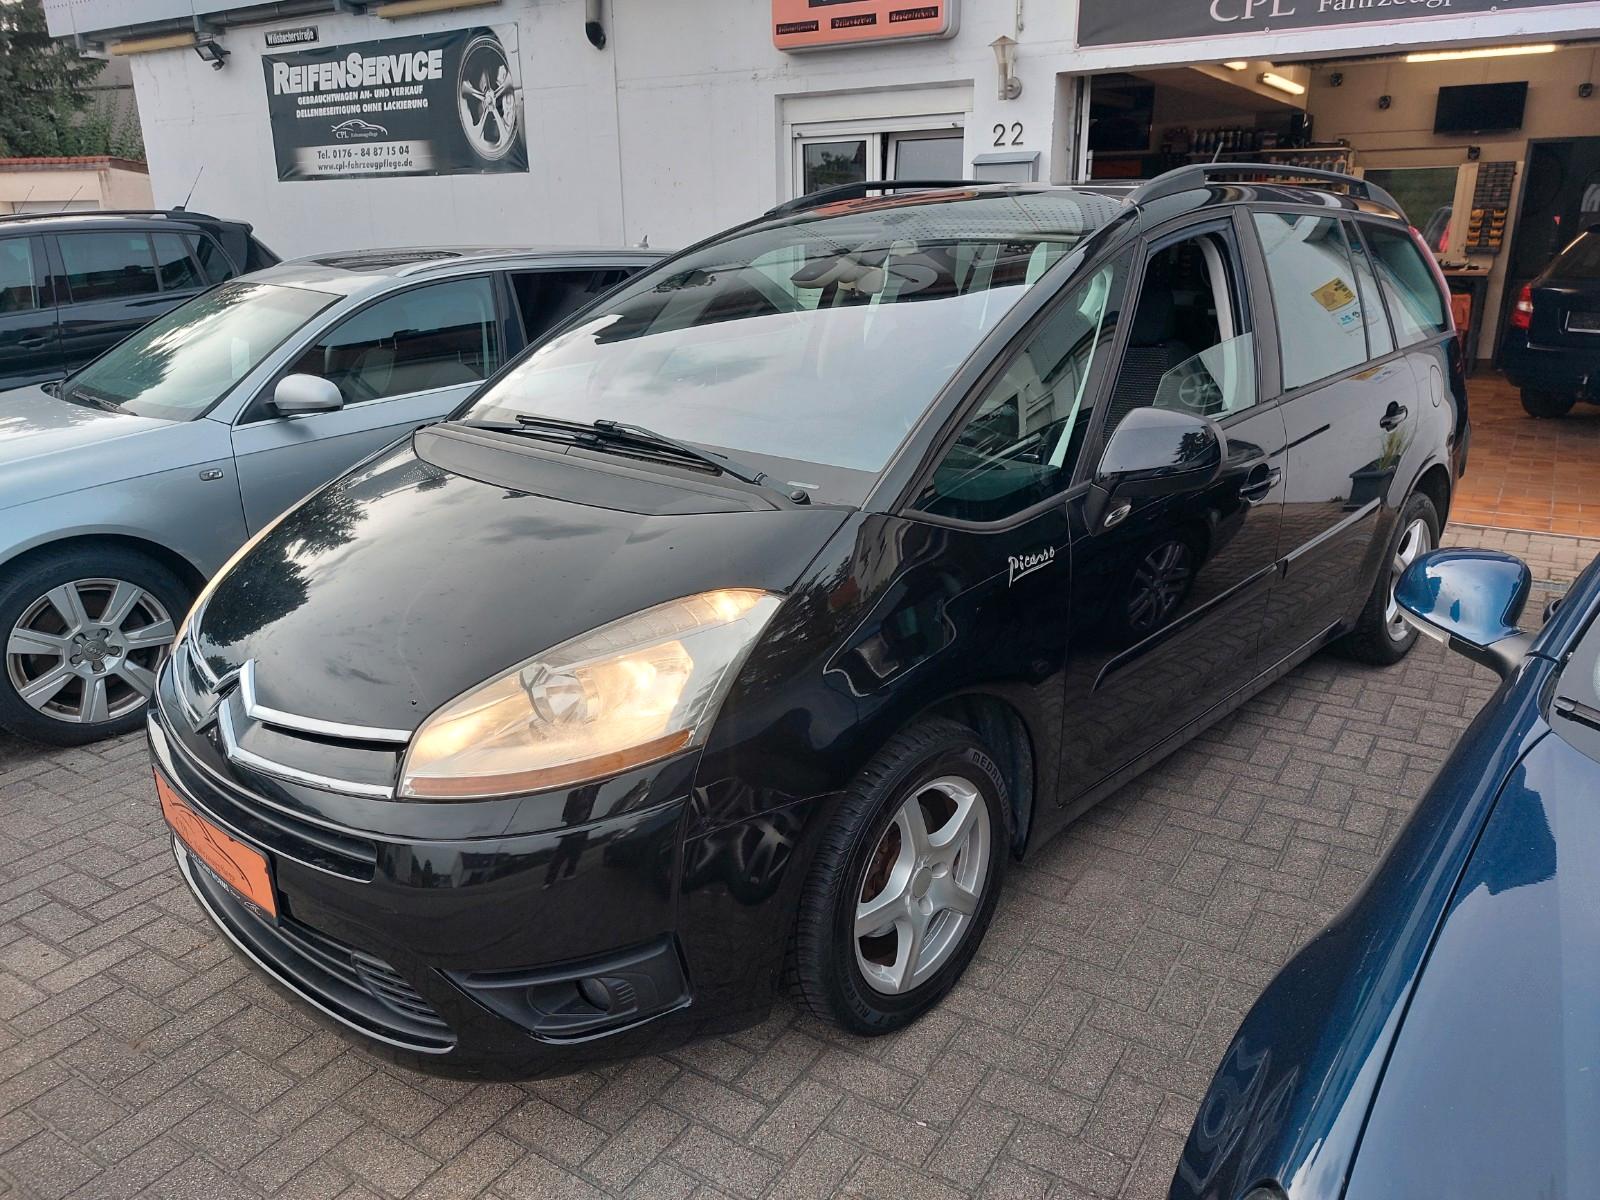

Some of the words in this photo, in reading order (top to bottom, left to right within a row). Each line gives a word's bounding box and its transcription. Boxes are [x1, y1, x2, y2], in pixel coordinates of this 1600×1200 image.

[297, 92, 359, 105] GEBRAUCHTWAGEN
[360, 91, 373, 100] AN-
[374, 89, 390, 98] UND
[391, 85, 423, 96] VERKAUF
[296, 104, 361, 118] DELLENBESEITIGUNG
[362, 102, 382, 112] OHNE
[383, 98, 429, 111] LACKIERUNG
[336, 131, 349, 139] CPL
[993, 122, 1024, 147] 22
[317, 149, 331, 159] Tel.
[332, 149, 352, 158] 0176
[360, 147, 371, 157] 84
[373, 147, 383, 156] 87
[386, 146, 396, 156] 15
[398, 145, 410, 155] 04
[318, 158, 413, 171] www.cpl-fahrzeugpflege.de
